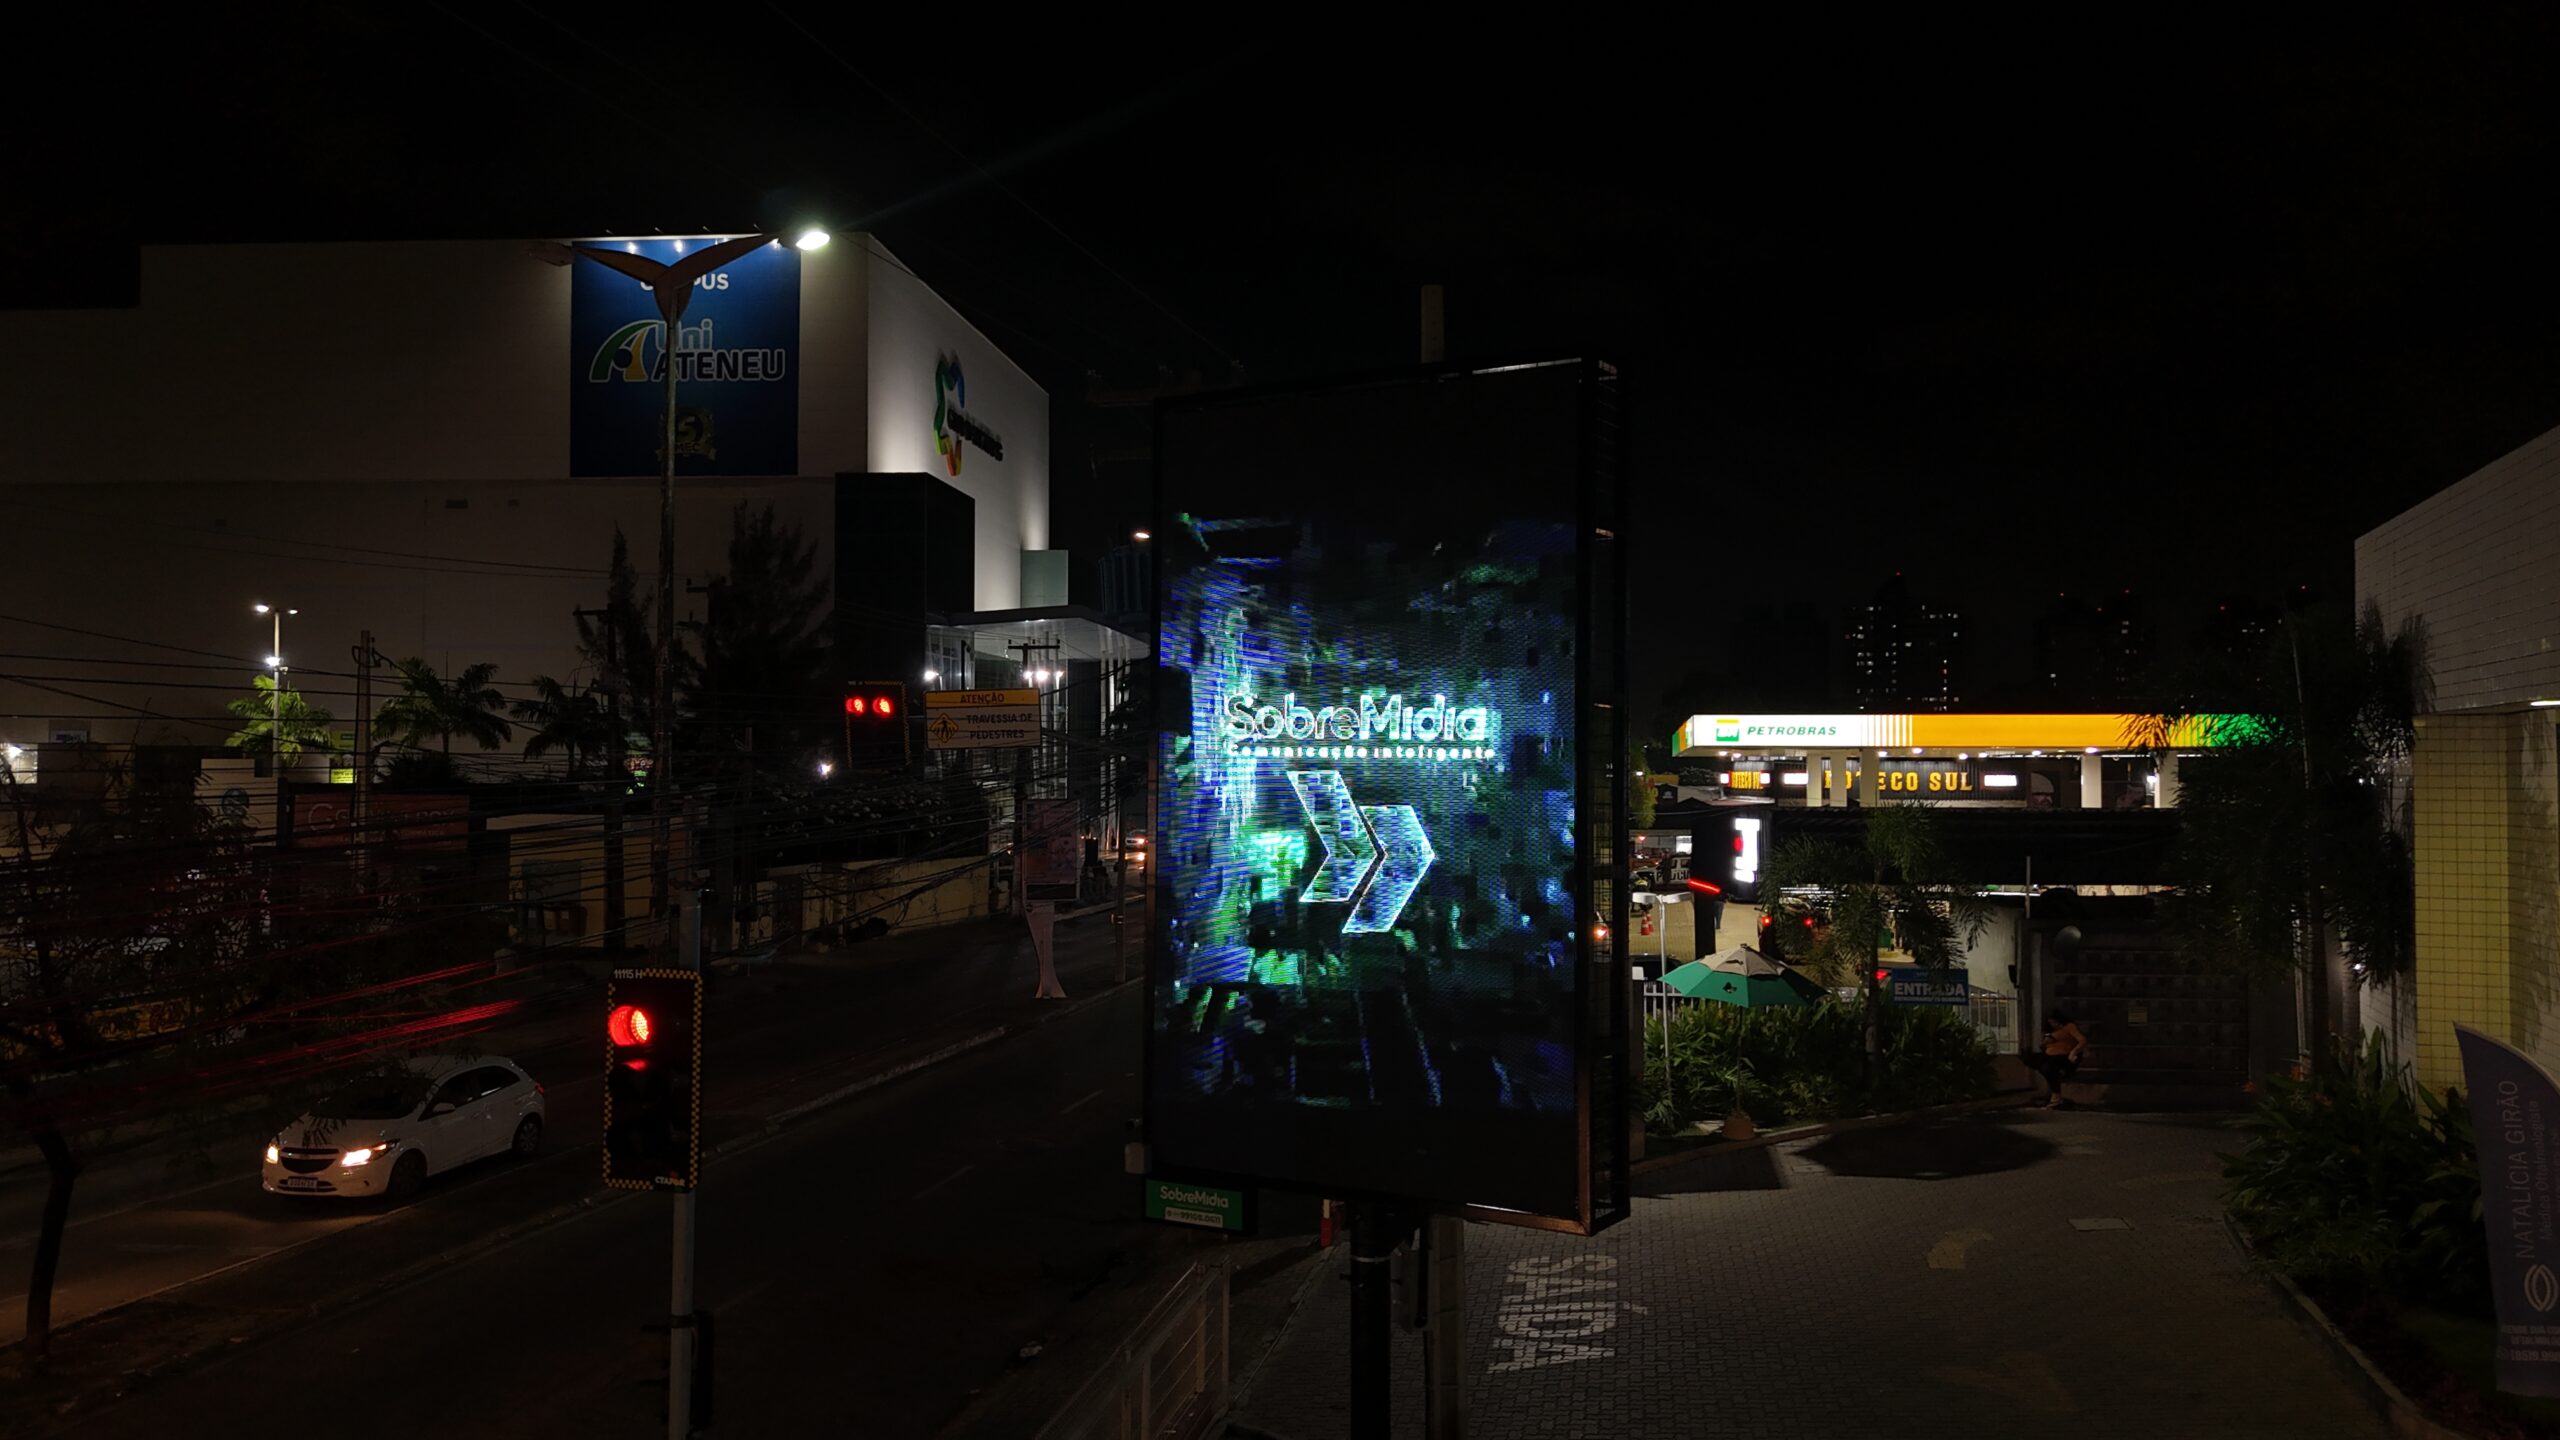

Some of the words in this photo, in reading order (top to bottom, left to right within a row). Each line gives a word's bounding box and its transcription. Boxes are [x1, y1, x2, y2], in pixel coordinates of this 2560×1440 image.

[651, 349, 786, 382] ATENEU
[961, 692, 1005, 704] ATENÇÃO
[966, 713, 1017, 724] TRAVESSIA
[1020, 713, 1033, 722] DE
[970, 729, 1025, 739] PEDESTRES
[1746, 726, 1837, 736] PETROBRAS
[1824, 769, 1919, 792] BECO
[1929, 770, 1973, 792] SUL
[2496, 1080, 2527, 1146] GIRÃO
[2506, 1151, 2535, 1259] NATALÍCIA
